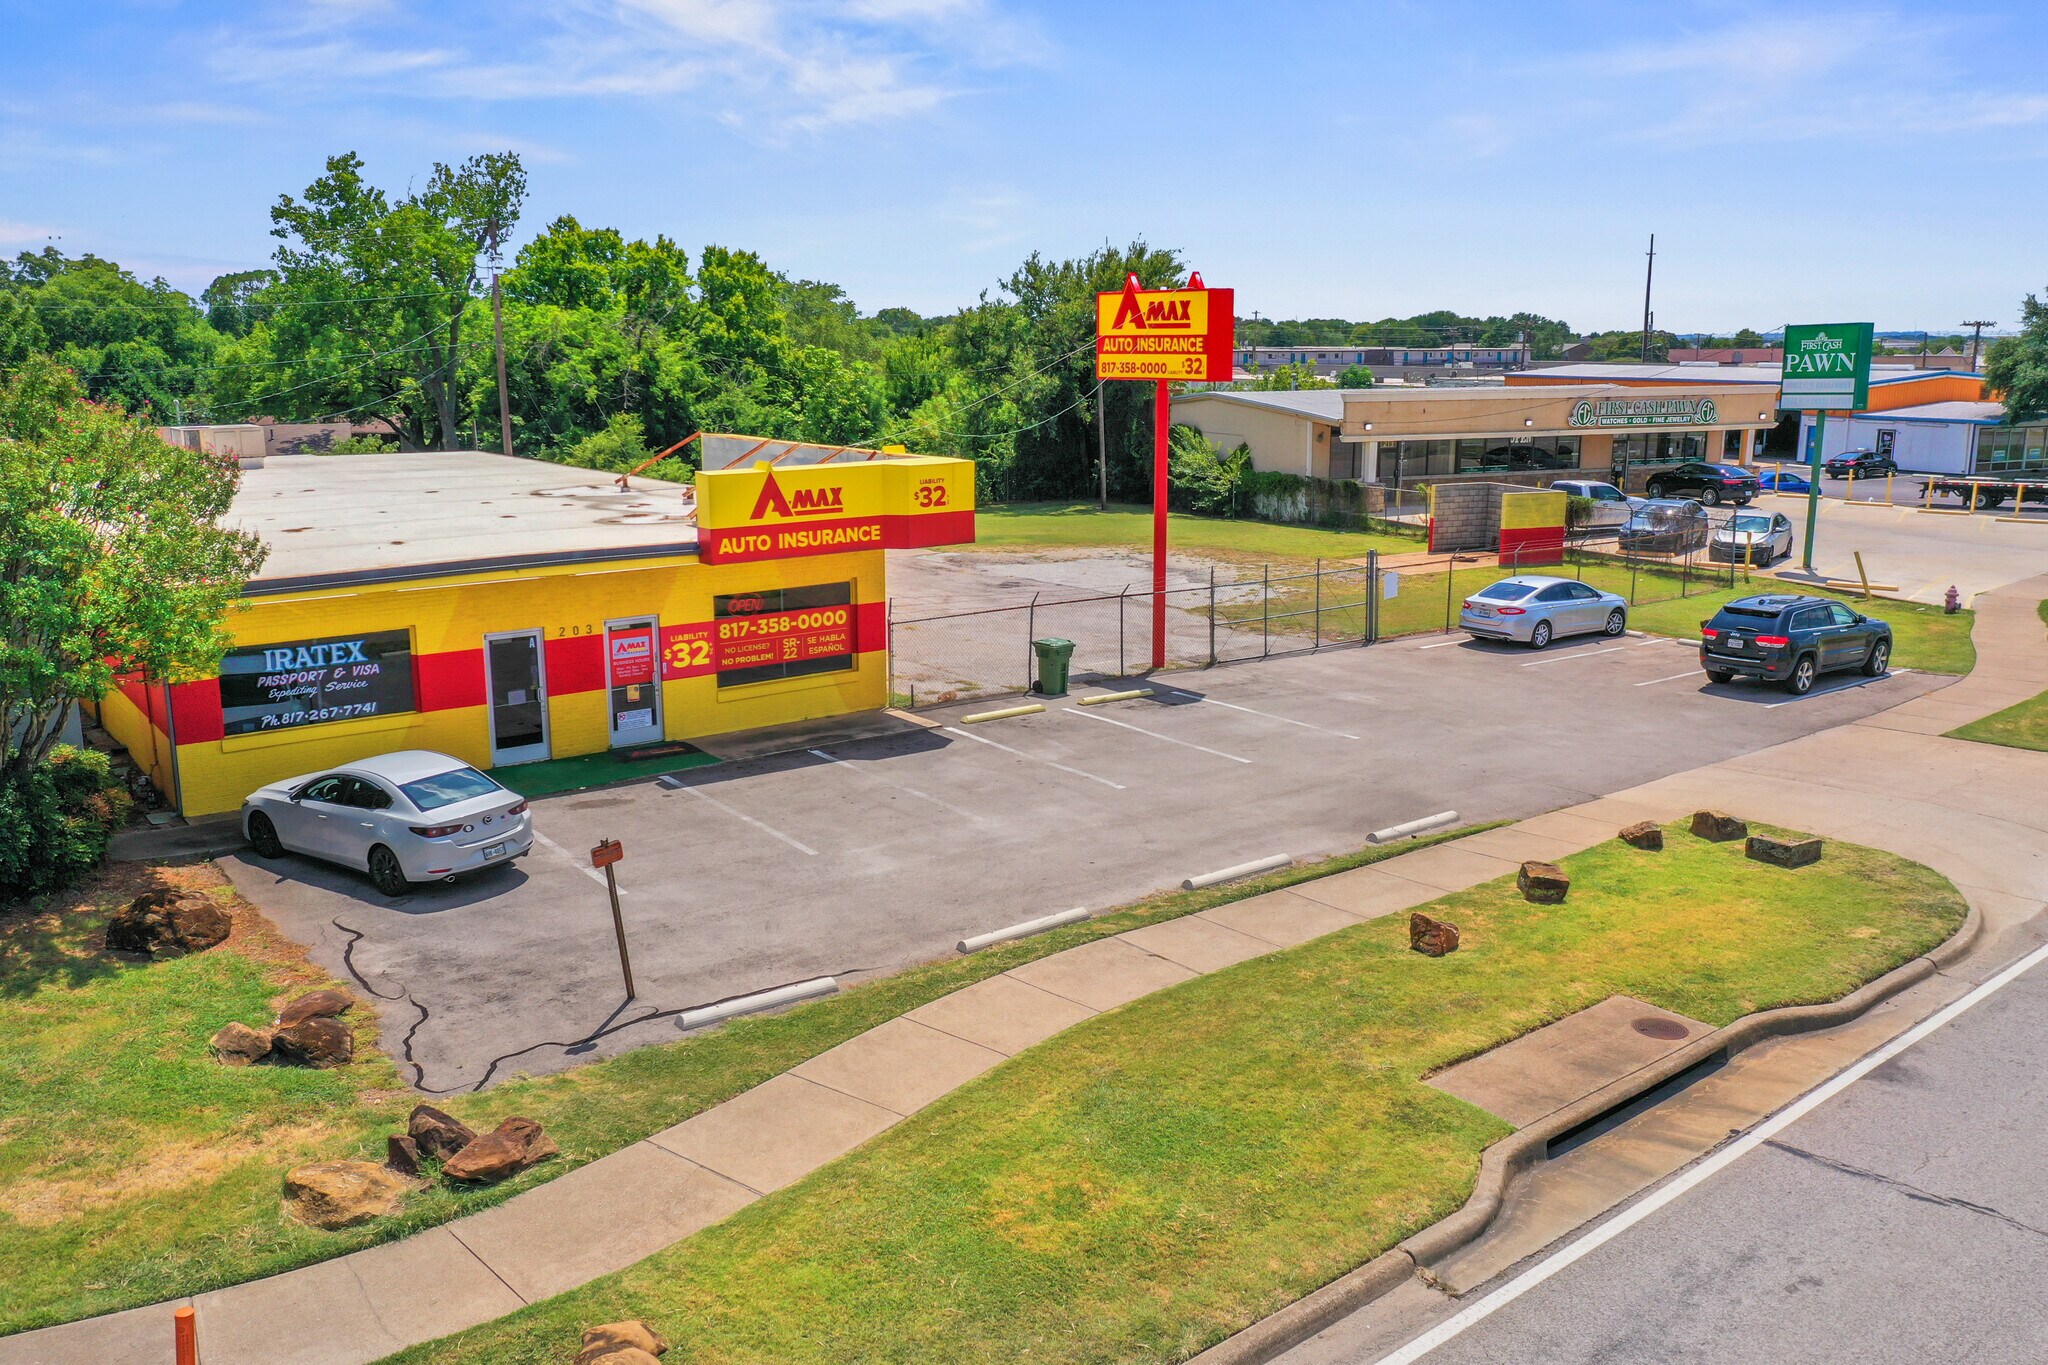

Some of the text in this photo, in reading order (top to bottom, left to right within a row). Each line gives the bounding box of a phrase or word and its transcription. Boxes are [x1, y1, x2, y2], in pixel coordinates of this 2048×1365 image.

[1103, 338, 1203, 352] AUTO INSURANCE
[1801, 342, 1843, 352] FIRST CASH
[1101, 361, 1167, 374] 817-358-0000
[1181, 357, 1203, 375] $32
[1784, 352, 1857, 373] PAWN
[1598, 399, 1697, 415] FIRST CASH PAWN
[1601, 417, 1628, 425] WATCHES
[914, 485, 946, 508] $32
[718, 524, 881, 555] AUTO INSURANCE
[728, 598, 762, 613] OPEN
[719, 609, 847, 640] 817-358-0000
[529, 637, 535, 648] A
[670, 631, 709, 642] LIABILITY
[807, 633, 846, 645] SE HABLA
[663, 640, 710, 668] $32
[737, 642, 771, 653] LICENSE?
[782, 648, 798, 660] 22
[808, 643, 845, 655] ESPAÑOL
[263, 639, 369, 672] IRATEX
[721, 652, 774, 666] NO PROBLEM!
[257, 663, 380, 688] PASSPORT & VISA
[268, 679, 369, 702] Expediting Service
